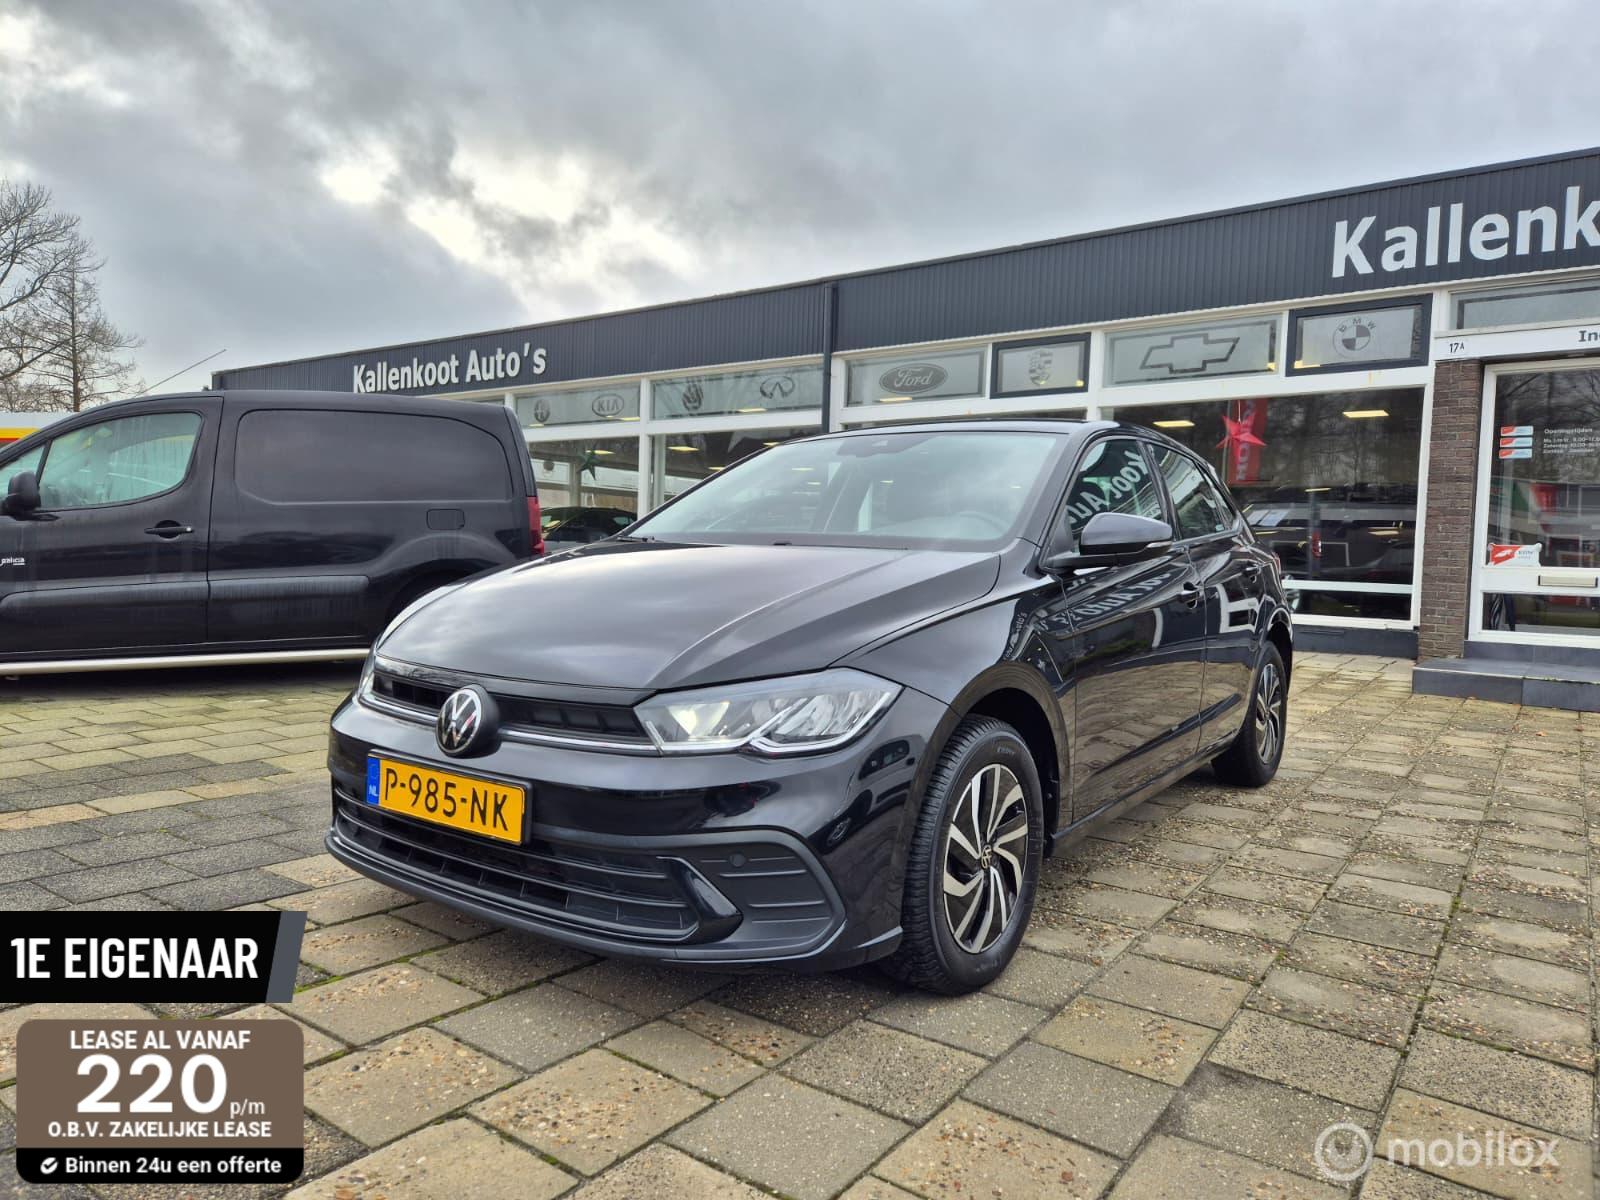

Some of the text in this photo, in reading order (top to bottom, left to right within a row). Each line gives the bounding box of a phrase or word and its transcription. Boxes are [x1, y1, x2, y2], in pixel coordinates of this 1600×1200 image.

[1578, 329, 1600, 342] In
[353, 342, 547, 393] Kallenkoot Auto's
[894, 367, 934, 388] Ford
[597, 399, 620, 412] KIA
[385, 768, 509, 831] P-985-NK
